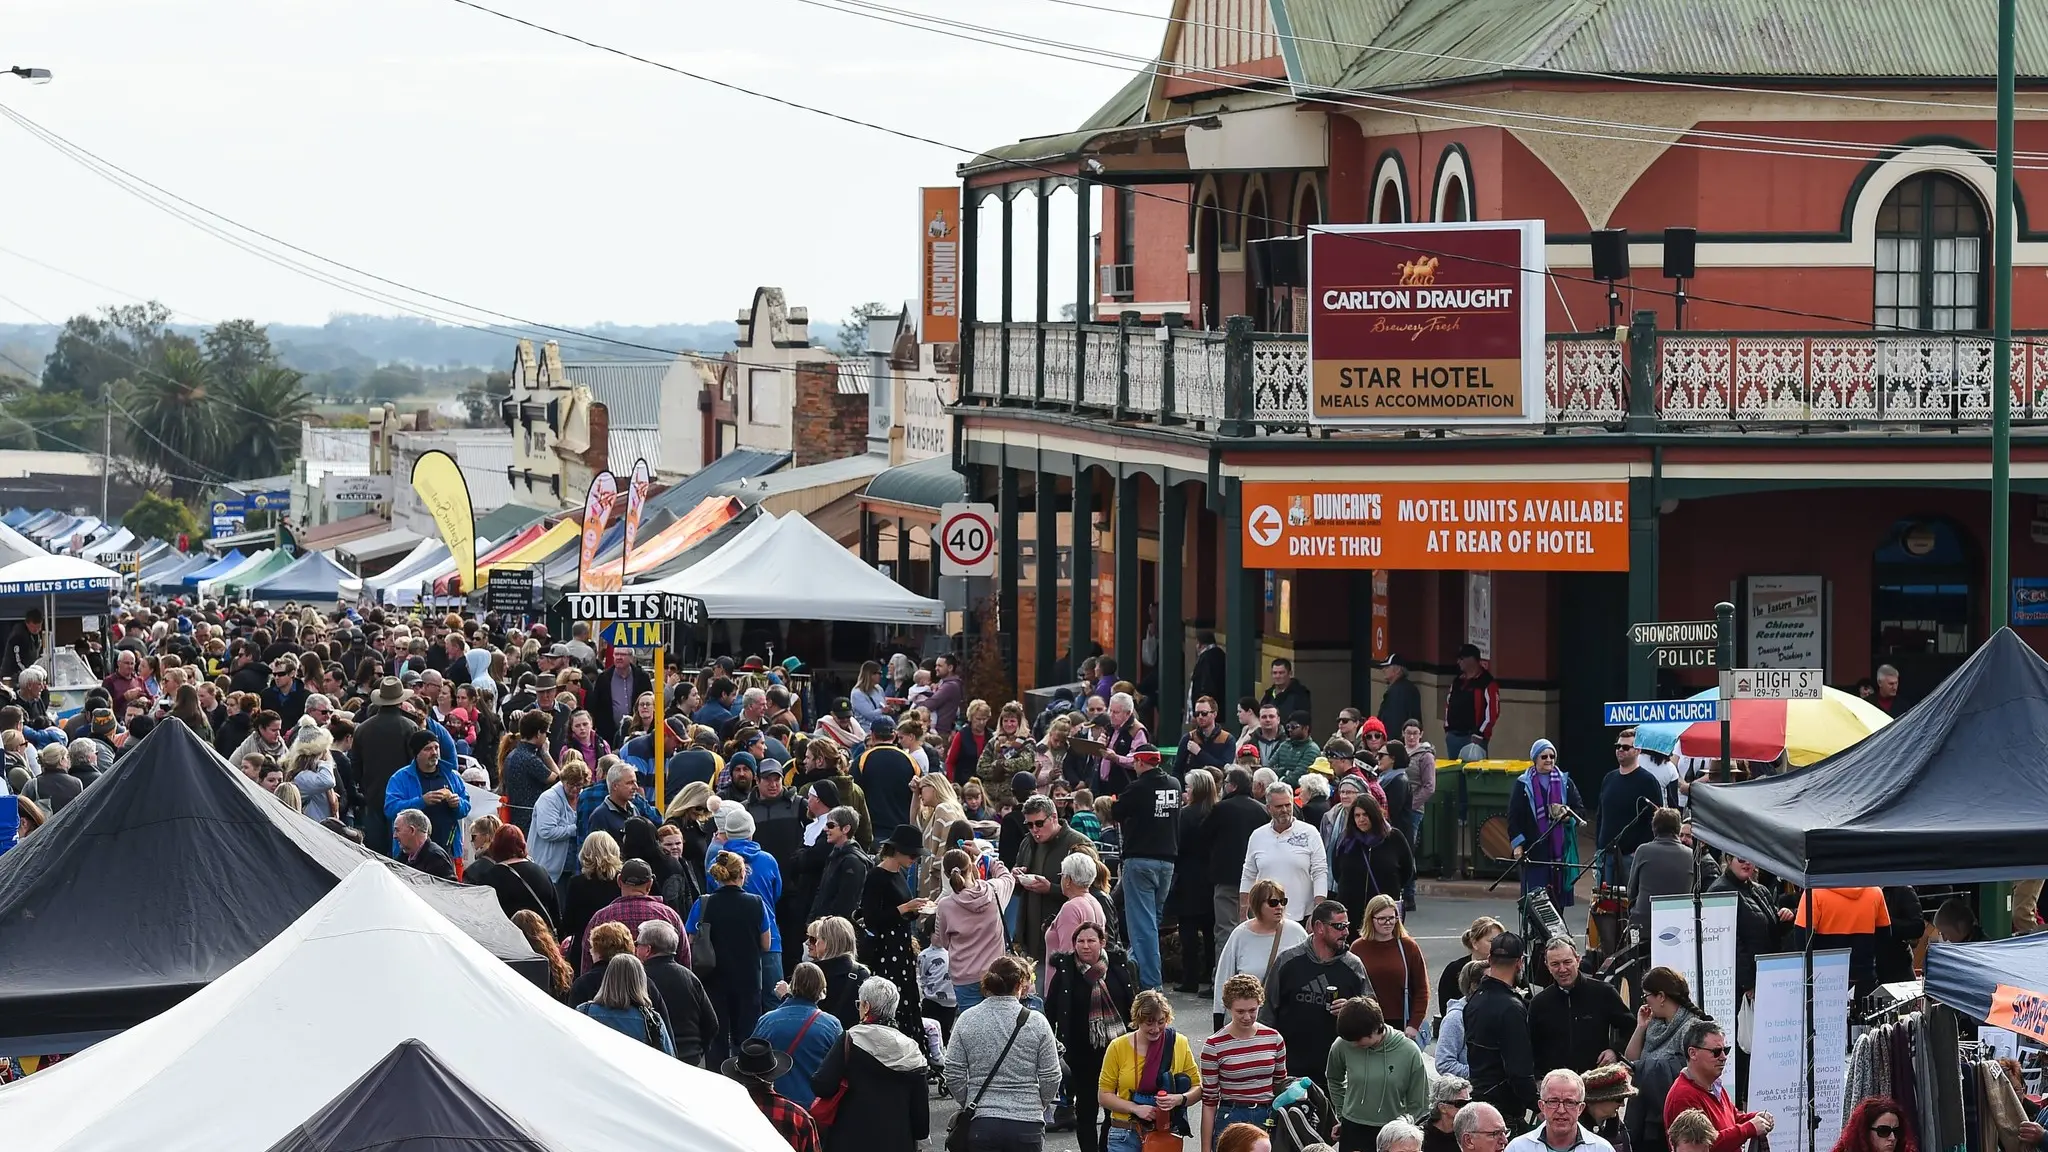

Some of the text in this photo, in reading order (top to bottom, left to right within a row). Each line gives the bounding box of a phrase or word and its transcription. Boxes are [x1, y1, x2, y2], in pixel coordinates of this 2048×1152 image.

[932, 241, 956, 316] DUNCAN'S
[1323, 289, 1513, 310] CARLTON DRAUGHT
[1370, 316, 1460, 341] Brewery Fresh
[1340, 368, 1494, 388] STAR HOTEL
[1320, 394, 1514, 408] MEALS ACCOMMODATION
[1314, 494, 1382, 520] DUNCAN'S
[1398, 500, 1623, 522] MOTEL UNITS AVAILABLE
[949, 528, 984, 551] 40
[1289, 536, 1381, 556] DRIVE THRU
[1427, 530, 1594, 553] AT REAR OF HOTEL
[101, 552, 136, 561] TOILETS
[24, 582, 62, 592] MELTS
[66, 580, 85, 590] ICE
[568, 596, 660, 619] TOILETS
[664, 595, 699, 624] OFFICE
[1768, 601, 1792, 613] Eastern
[1796, 594, 1817, 606] Palace
[614, 622, 661, 646] ATM
[1635, 624, 1718, 642] SHOWGROUNDS
[1756, 631, 1814, 639] Restaurant
[1783, 643, 1793, 651] and
[1659, 649, 1716, 666] POLICE
[1756, 672, 1790, 688] HIGH
[1754, 689, 1818, 697] 129-75 136-78
[1610, 702, 1712, 722] ANGLICAN CHURCH
[1155, 790, 1176, 804] 30
[1296, 992, 1326, 1005] adid
